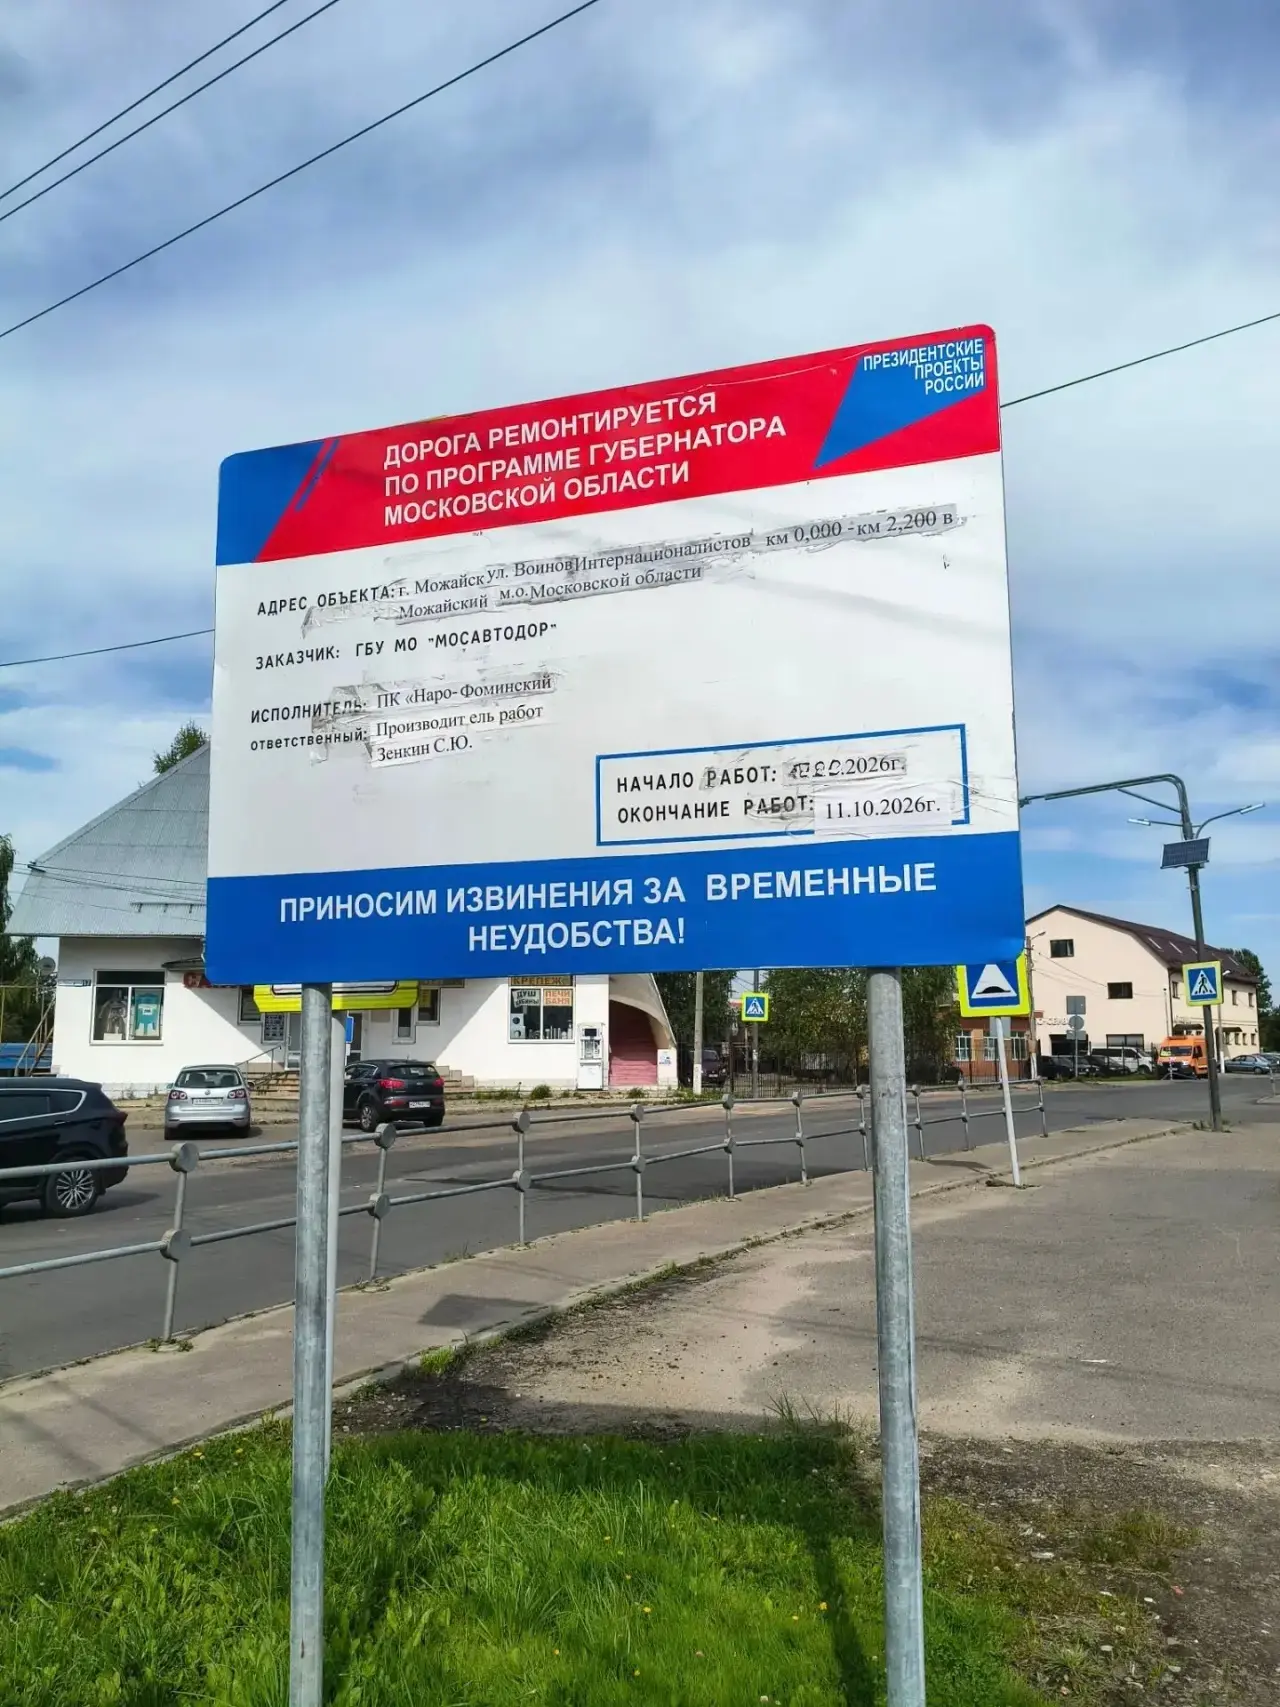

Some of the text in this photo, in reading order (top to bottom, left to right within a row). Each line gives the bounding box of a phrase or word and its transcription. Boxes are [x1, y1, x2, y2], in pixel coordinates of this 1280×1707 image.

[863, 338, 983, 371] ПРЕЗИДЕНТСКИЕ
[915, 355, 984, 380] ПРОЕКТЫ
[925, 371, 984, 395] РОССИИ
[384, 391, 716, 470] ДОРОГА РЕМОНТИРУЕТСЯ
[385, 415, 786, 497] ПО ПРОГРАММЕ ГУБЕРНАТОРА
[384, 460, 689, 527] МОСКОВСКОЙ ОБЛАСТИ
[257, 596, 307, 616] АДРЕС
[317, 585, 395, 608] ОБЪЕКТА:
[398, 586, 410, 597] г.
[415, 574, 485, 595] Можайск
[487, 568, 509, 584] ул.
[766, 534, 788, 547] км
[794, 521, 842, 543] 0,000
[886, 511, 937, 532] 2,200
[943, 512, 954, 525] в
[399, 595, 488, 619] Можайский
[635, 565, 702, 586] области
[255, 622, 557, 670] ЗАКАЗЧИК: ГБУ МО "МОСАВТОДОР"
[377, 692, 400, 708] ПК
[250, 728, 367, 751] ответственный:
[499, 704, 544, 725] работ
[377, 734, 473, 762] Зенкин С.Ю.
[617, 772, 694, 793] НАЧАЛО
[707, 765, 777, 788] РАБОТ:
[618, 794, 941, 824] ОКОНЧАНИЕ РАБОТ: 11.10.2026г.
[280, 862, 937, 923] ПРИНОСИМ ИЗВИНЕНИЯ ЗА ВРЕМЕННЫЕ
[469, 918, 686, 954] НЕУДОБСТВА!
